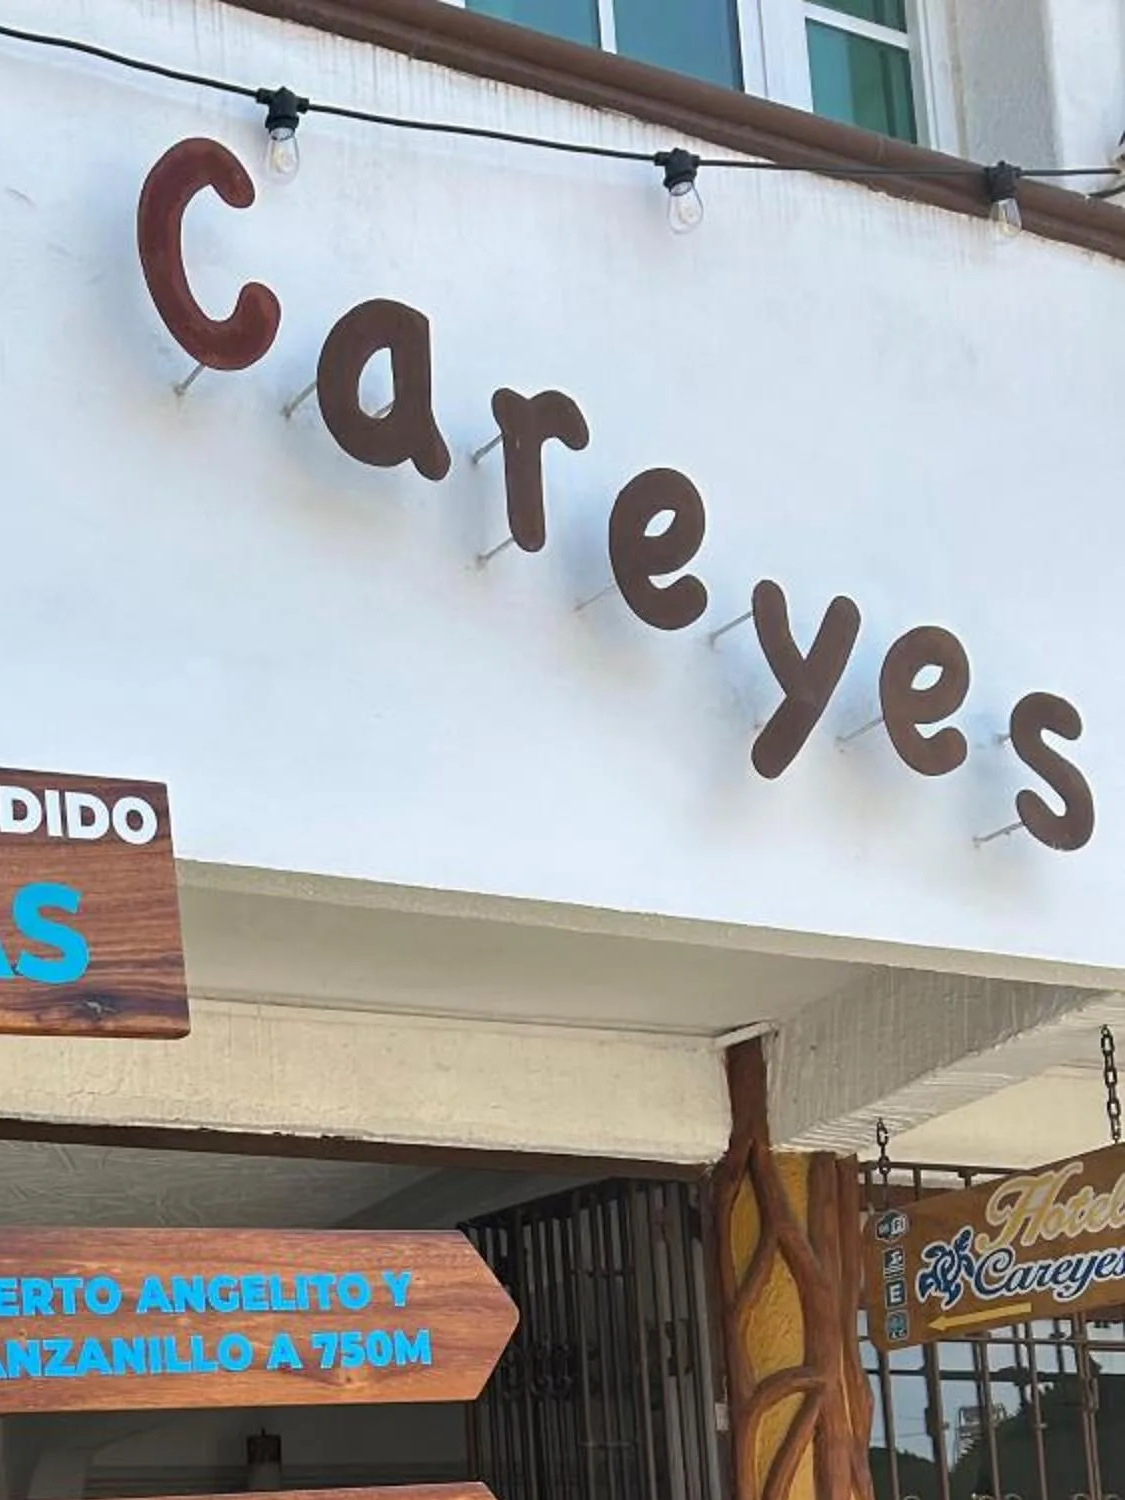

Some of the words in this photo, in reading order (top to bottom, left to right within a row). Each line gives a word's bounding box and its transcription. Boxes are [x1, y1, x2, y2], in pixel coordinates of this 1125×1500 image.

[137, 136, 1096, 851] Careyes
[975, 1161, 1125, 1253] Hotel
[138, 1274, 370, 1312] ANGELITO
[384, 1271, 412, 1307] Y
[268, 1335, 300, 1368] A
[312, 1332, 430, 1366] 750M
